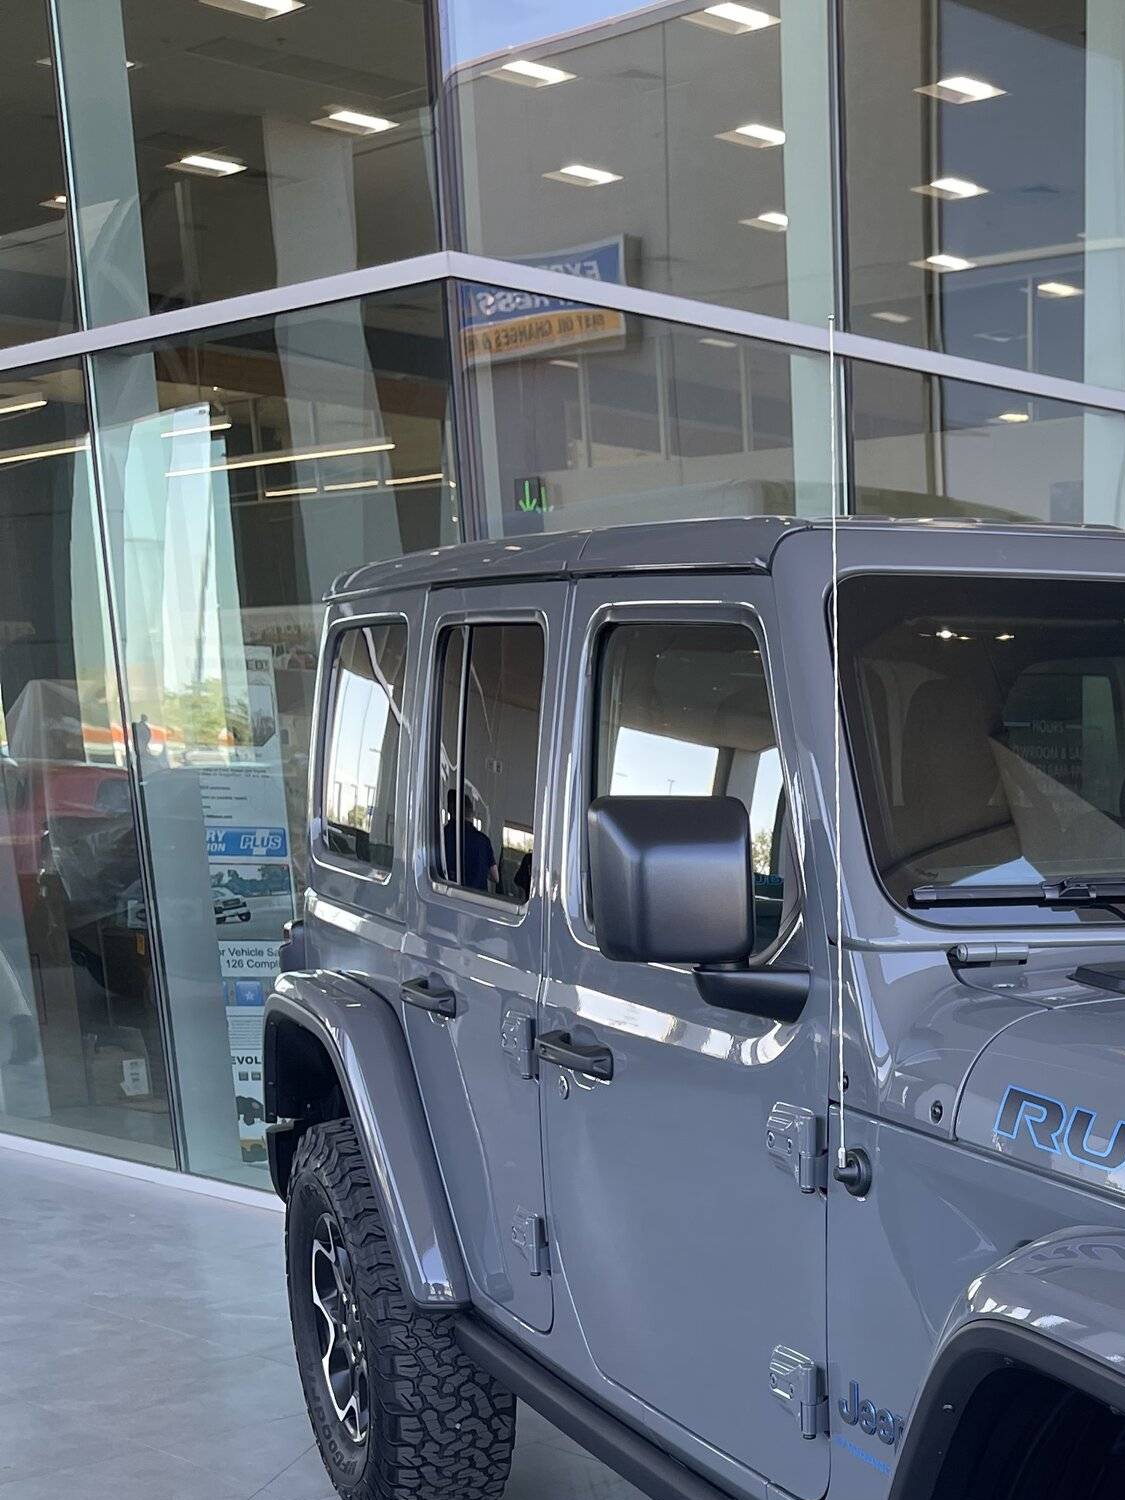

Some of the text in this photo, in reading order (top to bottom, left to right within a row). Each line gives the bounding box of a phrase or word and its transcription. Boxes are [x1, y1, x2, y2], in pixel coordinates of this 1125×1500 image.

[240, 834, 281, 850] PLUS
[228, 947, 264, 957] Vehicle
[226, 959, 244, 969] 126
